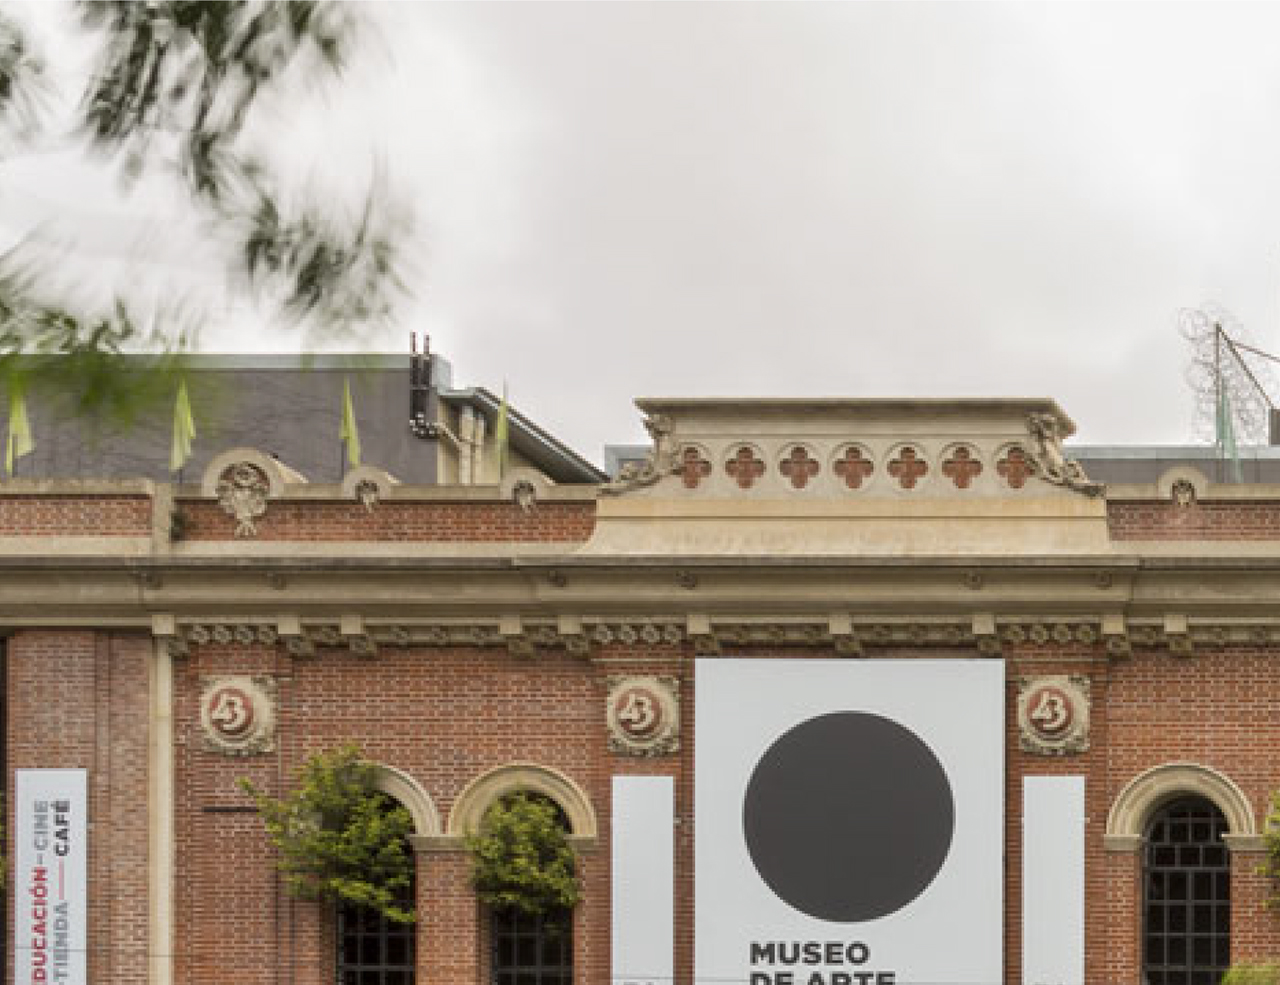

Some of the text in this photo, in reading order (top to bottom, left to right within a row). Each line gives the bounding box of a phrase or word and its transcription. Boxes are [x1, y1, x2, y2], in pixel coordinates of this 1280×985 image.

[33, 800, 48, 850] CINE
[50, 800, 70, 856] CAFÉ
[53, 902, 69, 981] TIENDA
[749, 942, 870, 965] MUSEO
